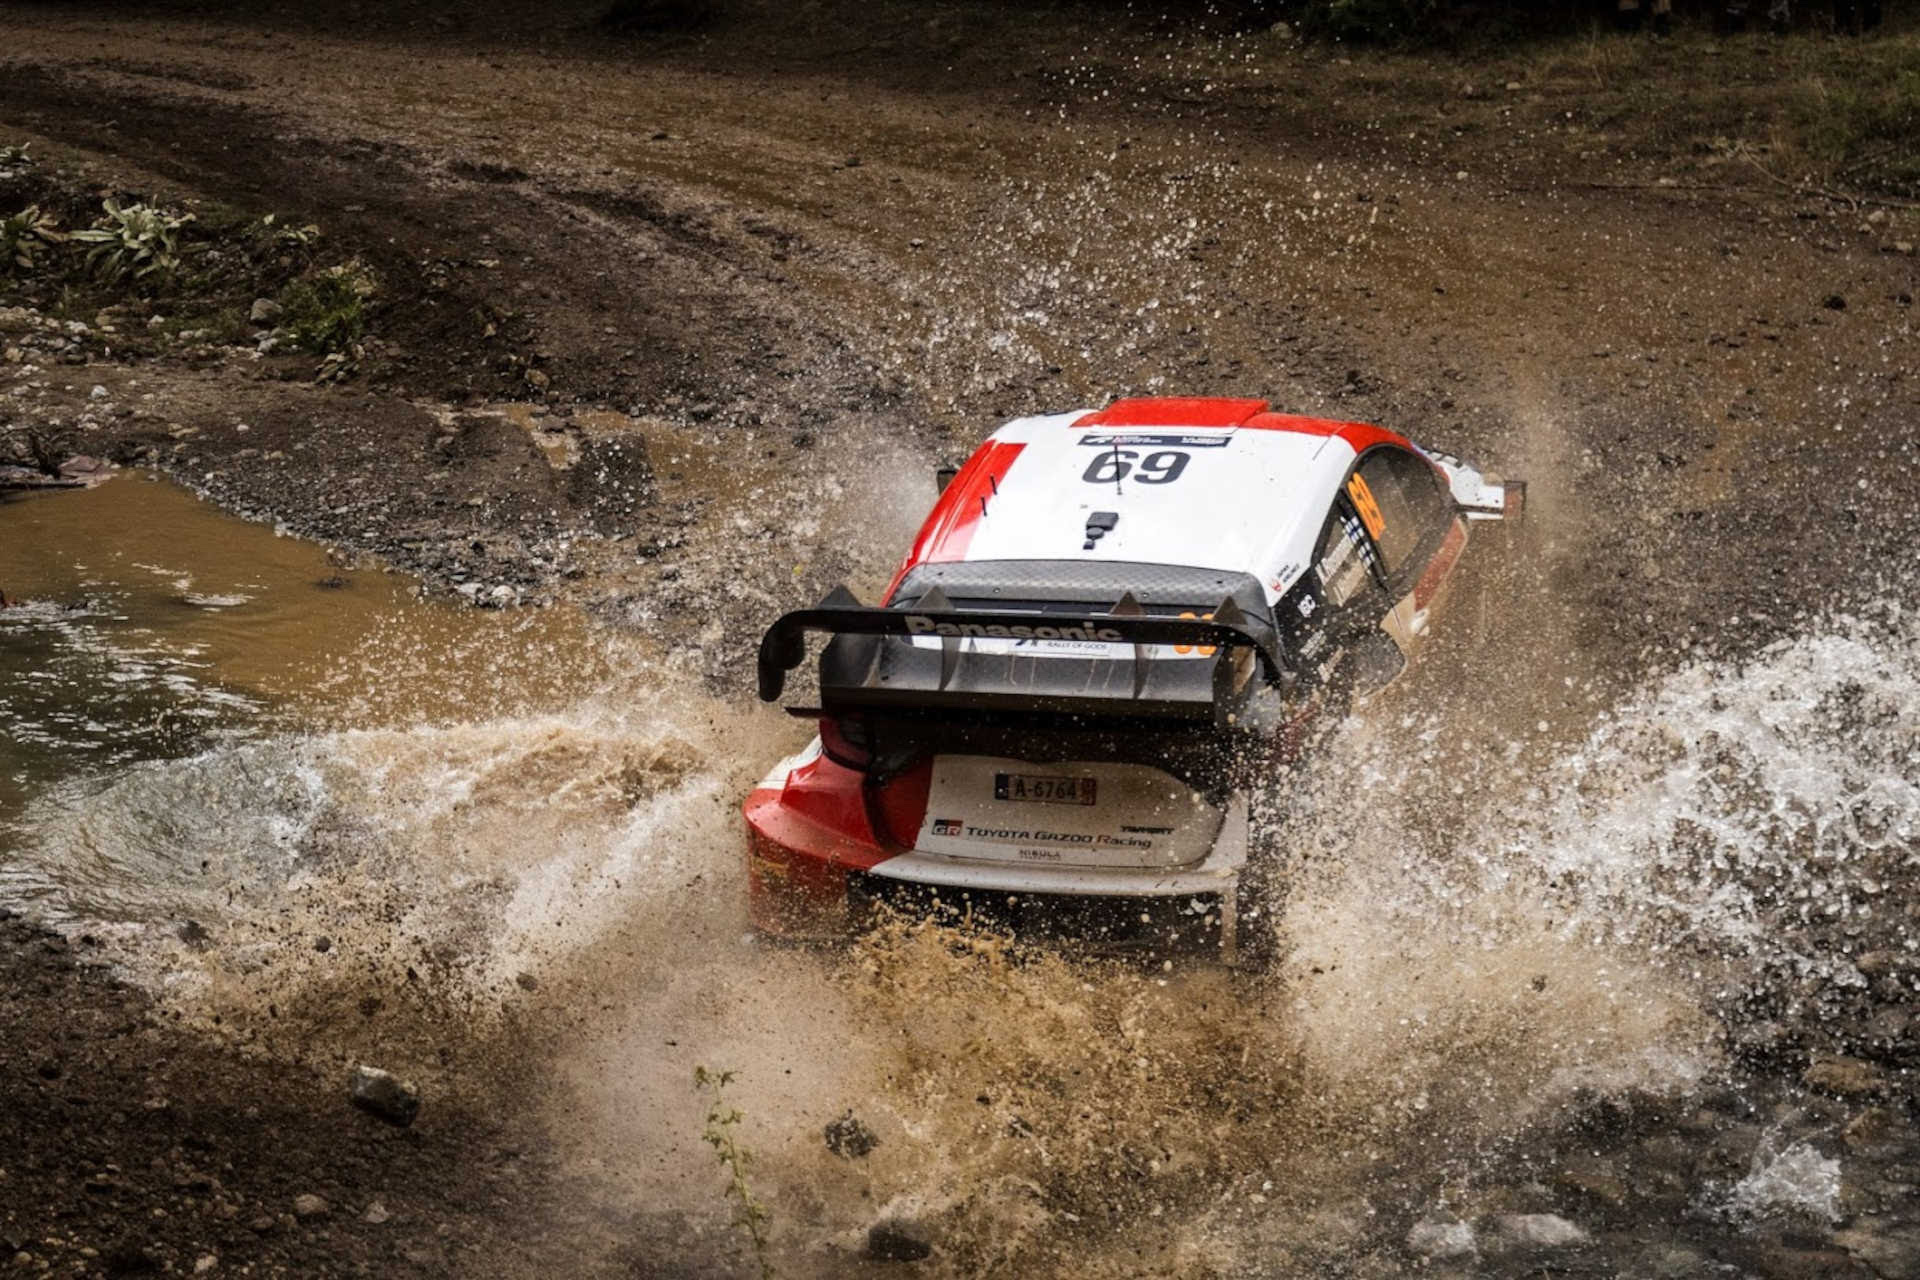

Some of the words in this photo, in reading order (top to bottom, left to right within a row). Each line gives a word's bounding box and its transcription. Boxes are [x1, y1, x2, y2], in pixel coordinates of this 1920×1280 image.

[1082, 451, 1191, 484] 69
[904, 615, 1123, 642] Panasonic
[1015, 779, 1077, 800] A-6764
[932, 822, 962, 836] GR
[966, 827, 1030, 840] TOYOTA
[1034, 831, 1093, 844] GAZOO
[1097, 834, 1152, 850] Racing
